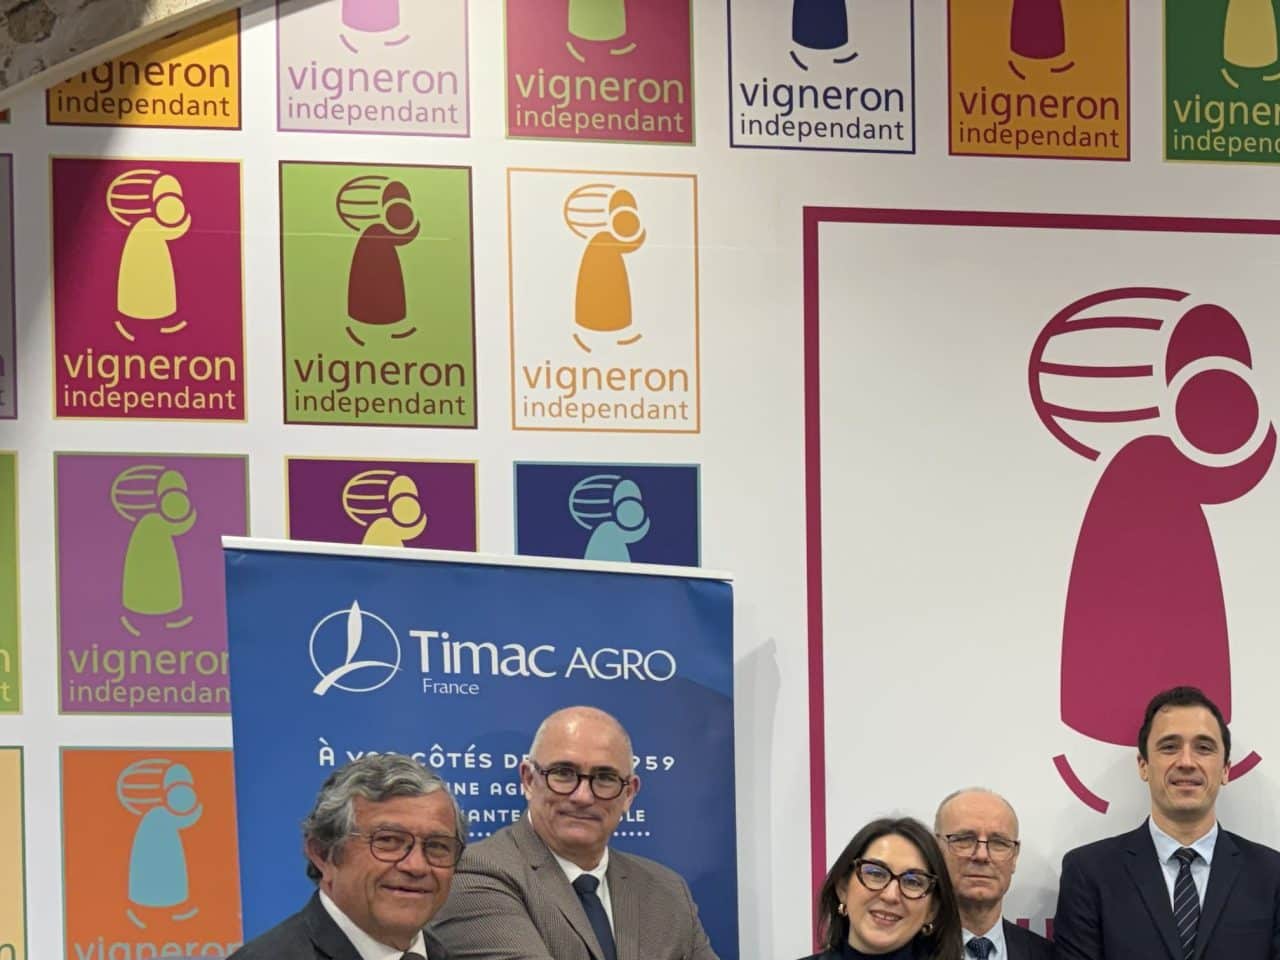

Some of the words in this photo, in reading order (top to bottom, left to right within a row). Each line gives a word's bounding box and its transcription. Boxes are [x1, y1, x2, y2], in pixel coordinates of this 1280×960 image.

[65, 57, 231, 93] gneron
[288, 61, 457, 100] vigneron
[516, 67, 685, 108] vigneron
[57, 89, 230, 119] independant
[288, 97, 458, 125] independant
[740, 78, 904, 116] vigneron
[960, 87, 1119, 125] vigneron
[515, 104, 685, 134] independant
[740, 113, 904, 143] independant
[960, 122, 1118, 149] independant
[64, 349, 235, 388] vigneron
[295, 354, 464, 392] vigneron
[523, 360, 688, 399] vigneron
[65, 385, 235, 412] independant
[296, 390, 464, 417] independant
[524, 396, 688, 423] independant
[409, 630, 557, 678] Timac
[565, 648, 677, 681] AGRO
[69, 679, 230, 707] independan
[423, 678, 480, 696] France
[319, 736, 335, 767] À
[633, 755, 675, 771] 959
